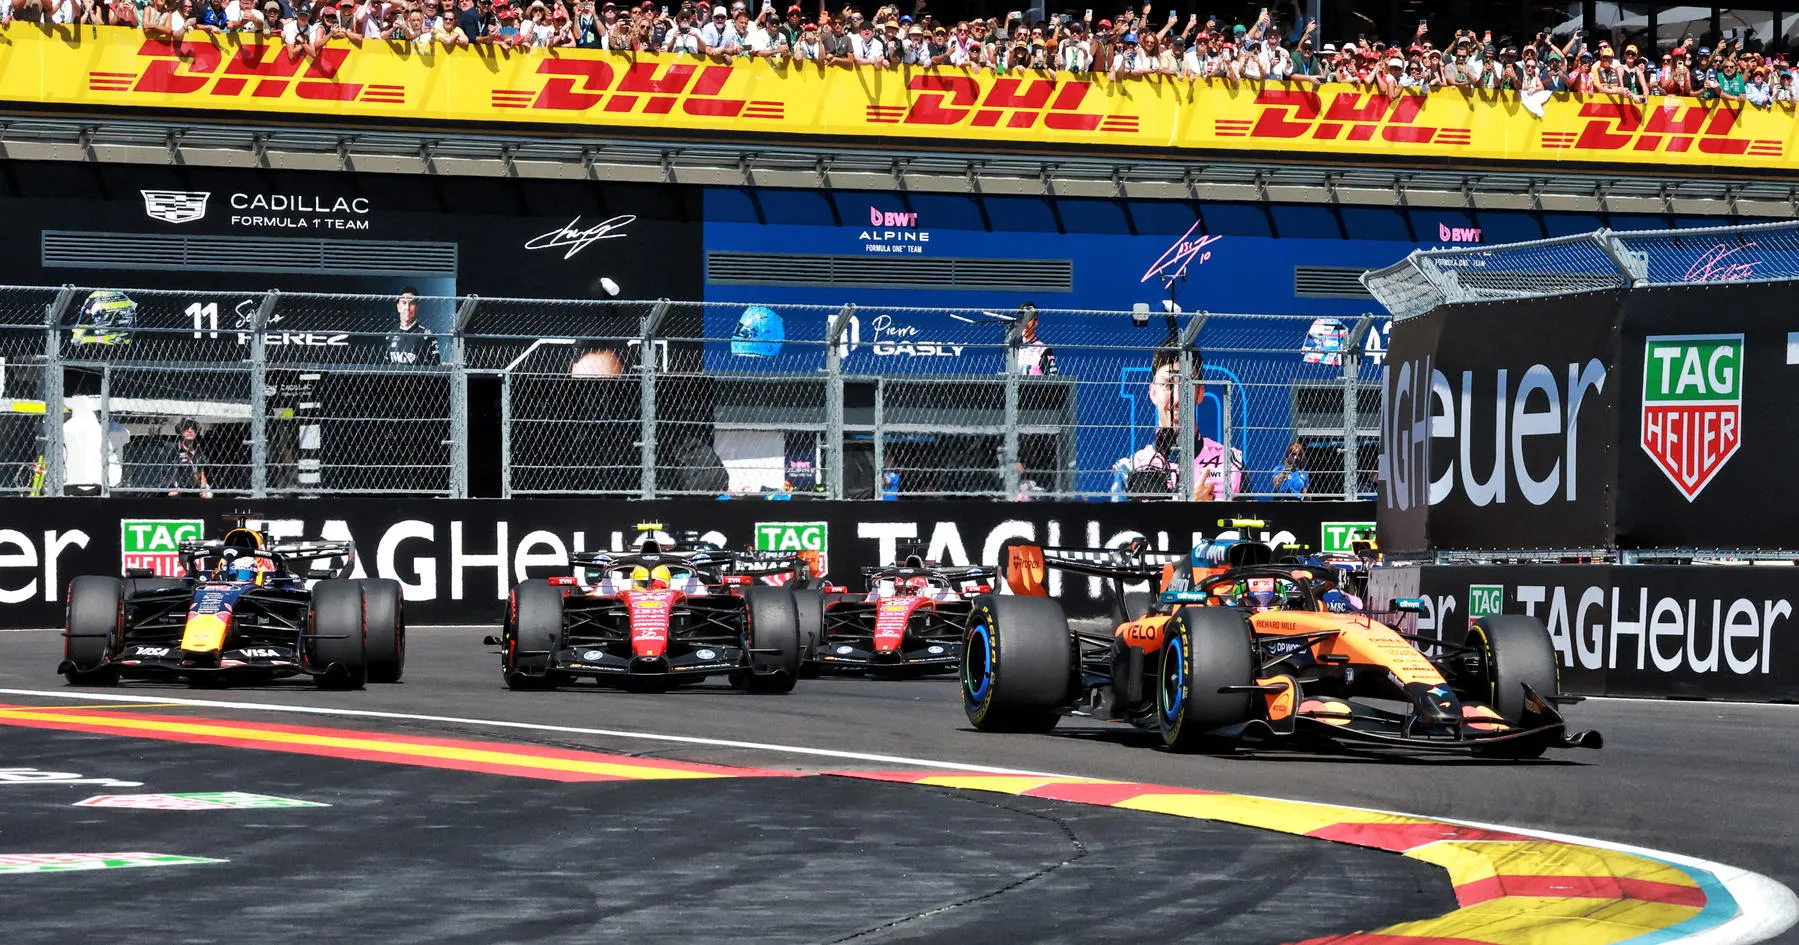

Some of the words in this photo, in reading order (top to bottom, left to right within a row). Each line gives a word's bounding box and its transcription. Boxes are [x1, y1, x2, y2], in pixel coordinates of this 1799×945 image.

[134, 39, 363, 101] DHL
[533, 58, 750, 119] DHL
[902, 75, 1104, 131] DHL
[1249, 89, 1439, 143] DHL
[1575, 102, 1751, 155] DHL
[230, 193, 369, 213] CADILLAC
[231, 215, 308, 228] FORMULA
[324, 219, 369, 229] TEAM
[884, 212, 918, 227] BWT
[859, 231, 929, 241] ALPINE
[1452, 228, 1481, 242] BWT
[865, 244, 891, 252] FORMULA
[907, 245, 922, 253] TEAM
[185, 302, 218, 339] 11
[872, 314, 920, 343] Pierre
[873, 340, 966, 357] GASLY
[1653, 345, 1734, 394] TAG
[1647, 411, 1735, 488] HEUER
[128, 525, 197, 550] TAG
[761, 526, 823, 551] TAG
[1327, 527, 1377, 549] TA
[1330, 602, 1346, 612] MSC
[1472, 590, 1500, 614] TAG
[1256, 620, 1280, 629] RICHARD
[1281, 621, 1296, 630] MILLE
[1517, 585, 1793, 675] TAGHeuer
[136, 646, 169, 656] VISA
[241, 649, 281, 657] VISA
